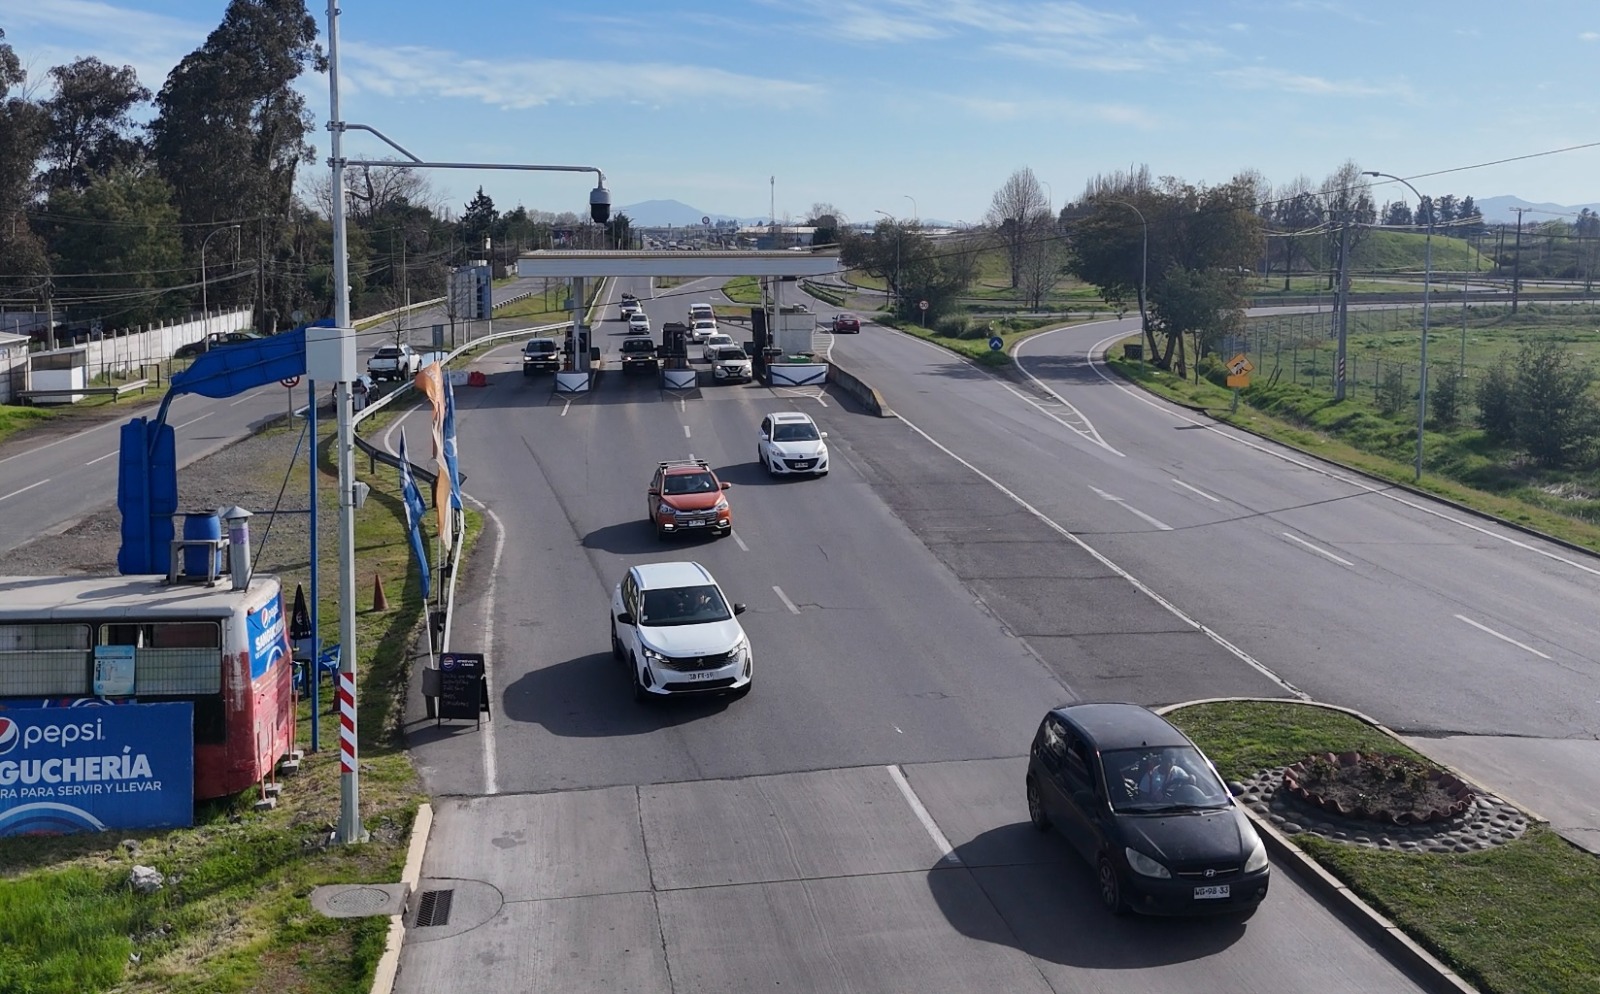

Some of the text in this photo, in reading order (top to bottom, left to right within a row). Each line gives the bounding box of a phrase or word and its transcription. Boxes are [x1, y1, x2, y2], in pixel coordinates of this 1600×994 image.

[24, 718, 103, 749] pepsi
[0, 745, 153, 785] GUCHERÍA
[20, 787, 55, 797] PARA
[57, 783, 102, 796] SERVIR
[105, 783, 113, 793] Y
[115, 780, 162, 792] LLEVAR
